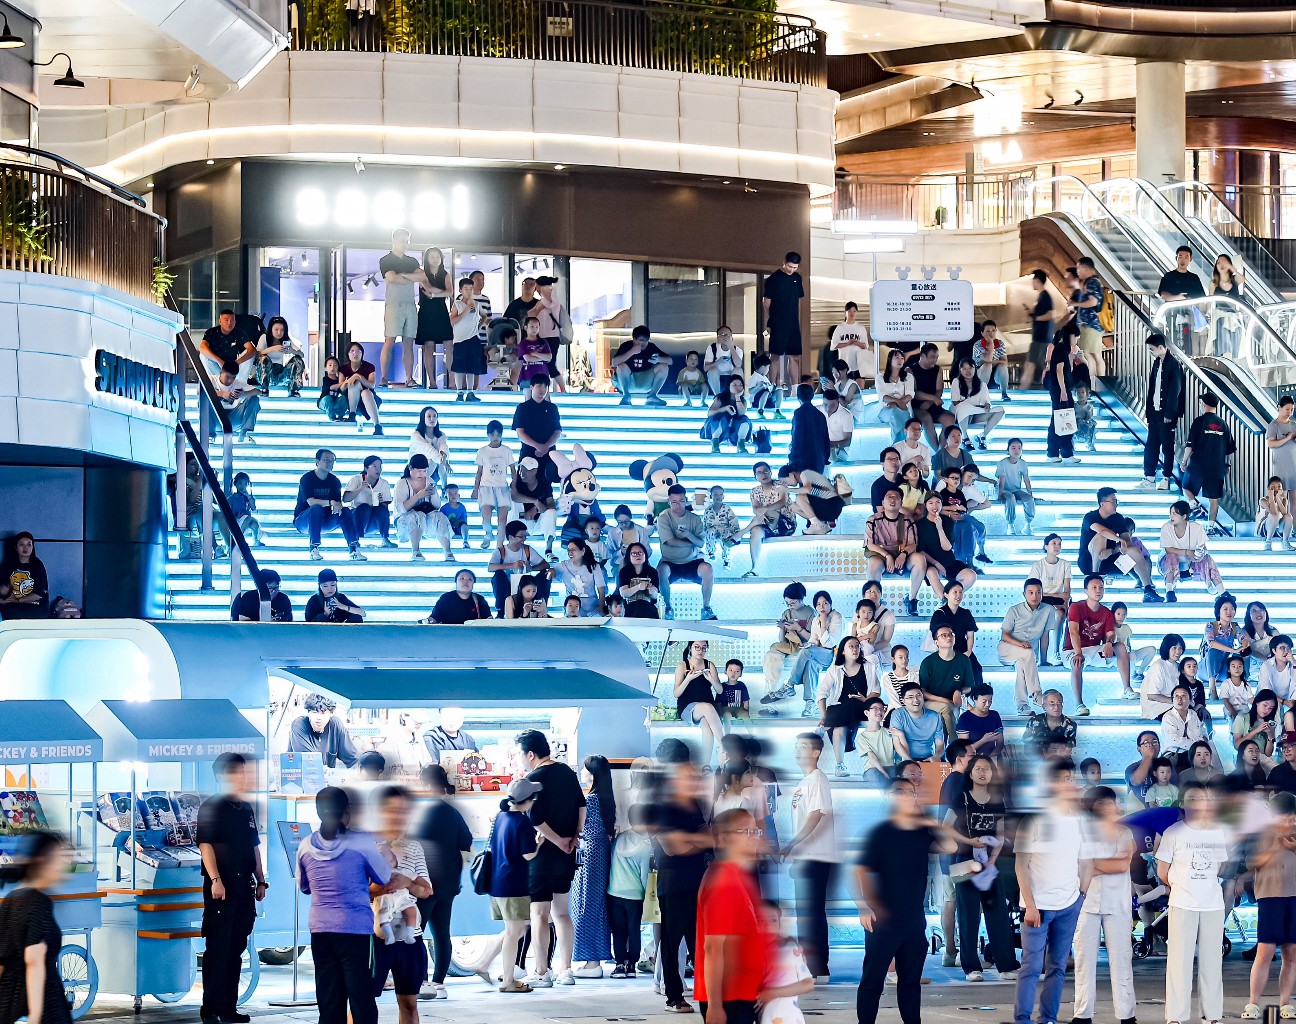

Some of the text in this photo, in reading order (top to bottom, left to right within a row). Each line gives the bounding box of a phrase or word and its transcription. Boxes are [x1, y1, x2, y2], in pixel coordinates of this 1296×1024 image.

[95, 348, 179, 413] STARBUCKS
[29, 746, 38, 758] &
[41, 744, 92, 758] FRIENDS
[149, 742, 256, 757] MICKEY & FRIENDS
